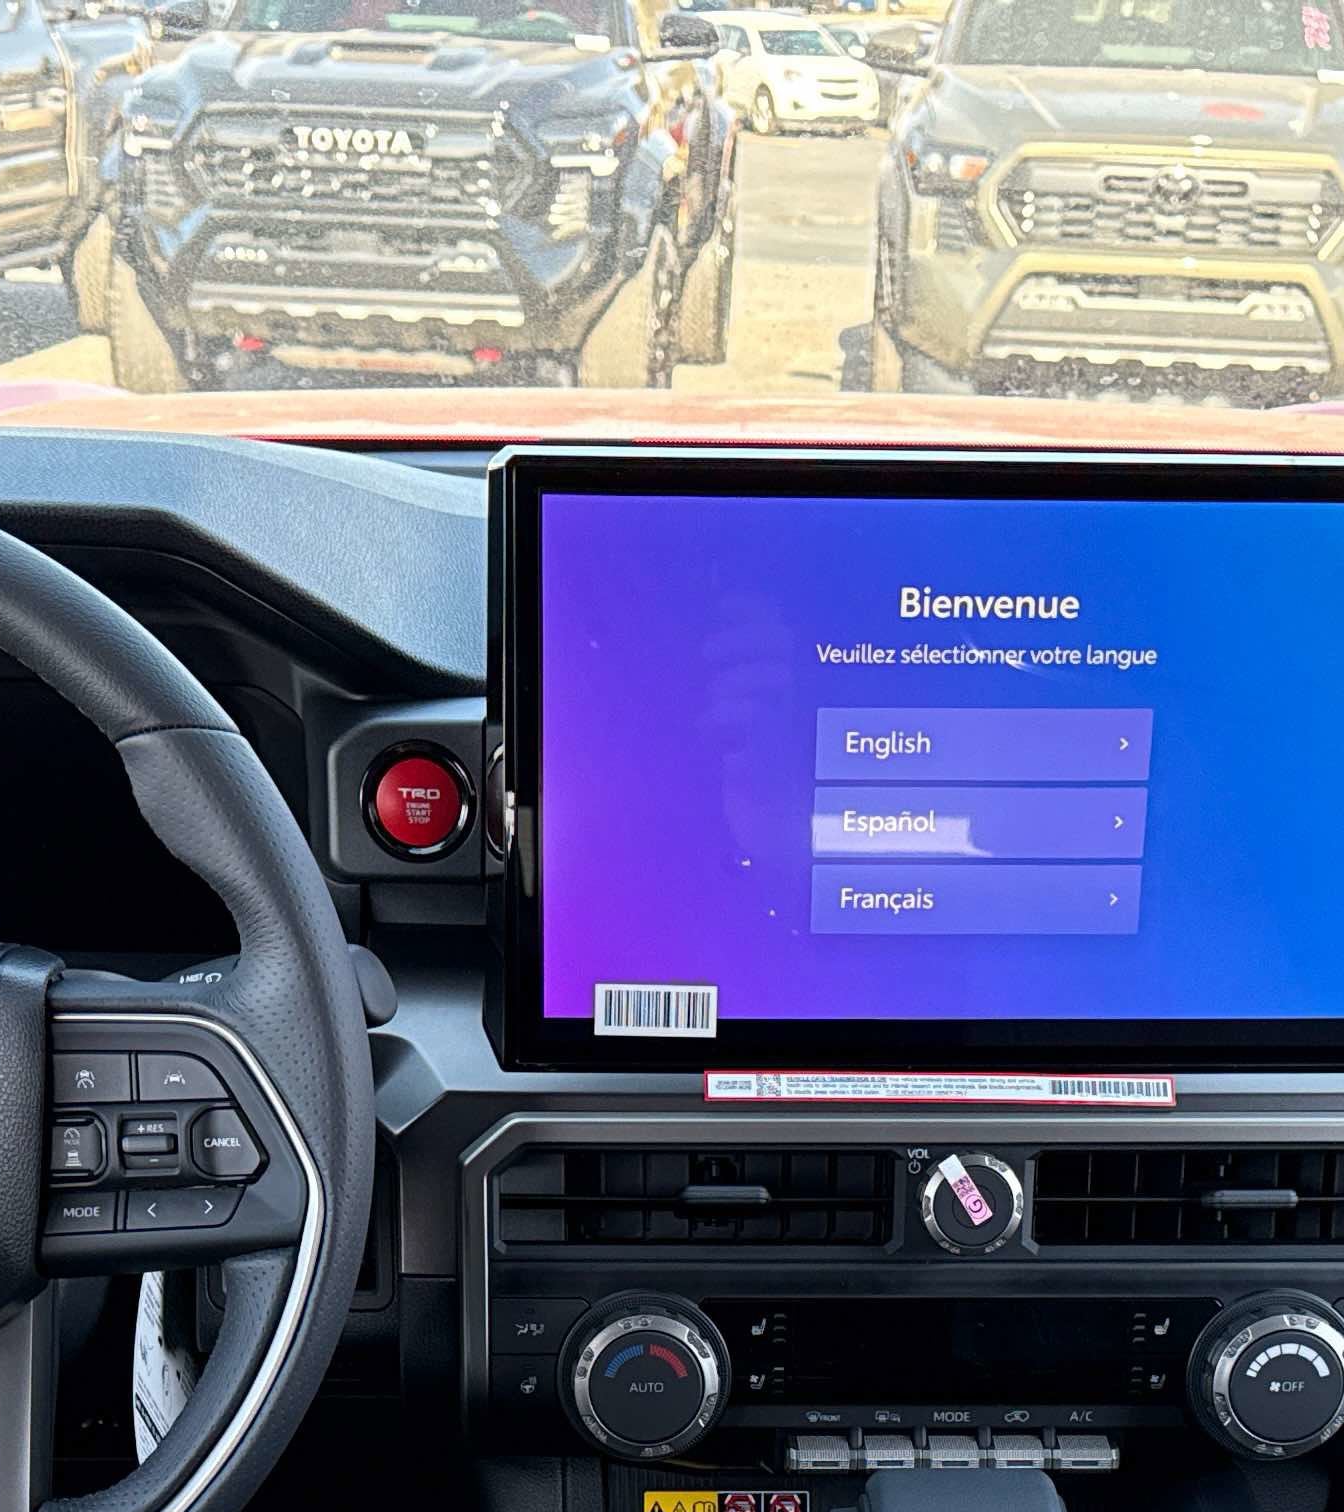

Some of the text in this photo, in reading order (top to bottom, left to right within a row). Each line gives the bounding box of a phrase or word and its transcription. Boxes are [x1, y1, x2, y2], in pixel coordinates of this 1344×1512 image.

[293, 125, 413, 155] TOYOTA
[899, 586, 1081, 619] Bienvenue
[816, 643, 1158, 670] Veuillez sélectionner votre langue
[845, 731, 932, 759] English
[397, 787, 441, 800] TRD
[405, 809, 432, 817] START
[843, 810, 936, 836] Español
[840, 887, 934, 914] Français
[203, 1138, 241, 1148] CANCEL
[907, 1149, 930, 1159] VOL
[63, 1205, 101, 1218] MODE
[629, 1381, 664, 1393] AUTO
[1281, 1380, 1305, 1393] OFF
[932, 1410, 971, 1423] MODE
[1069, 1409, 1095, 1423] A/C
